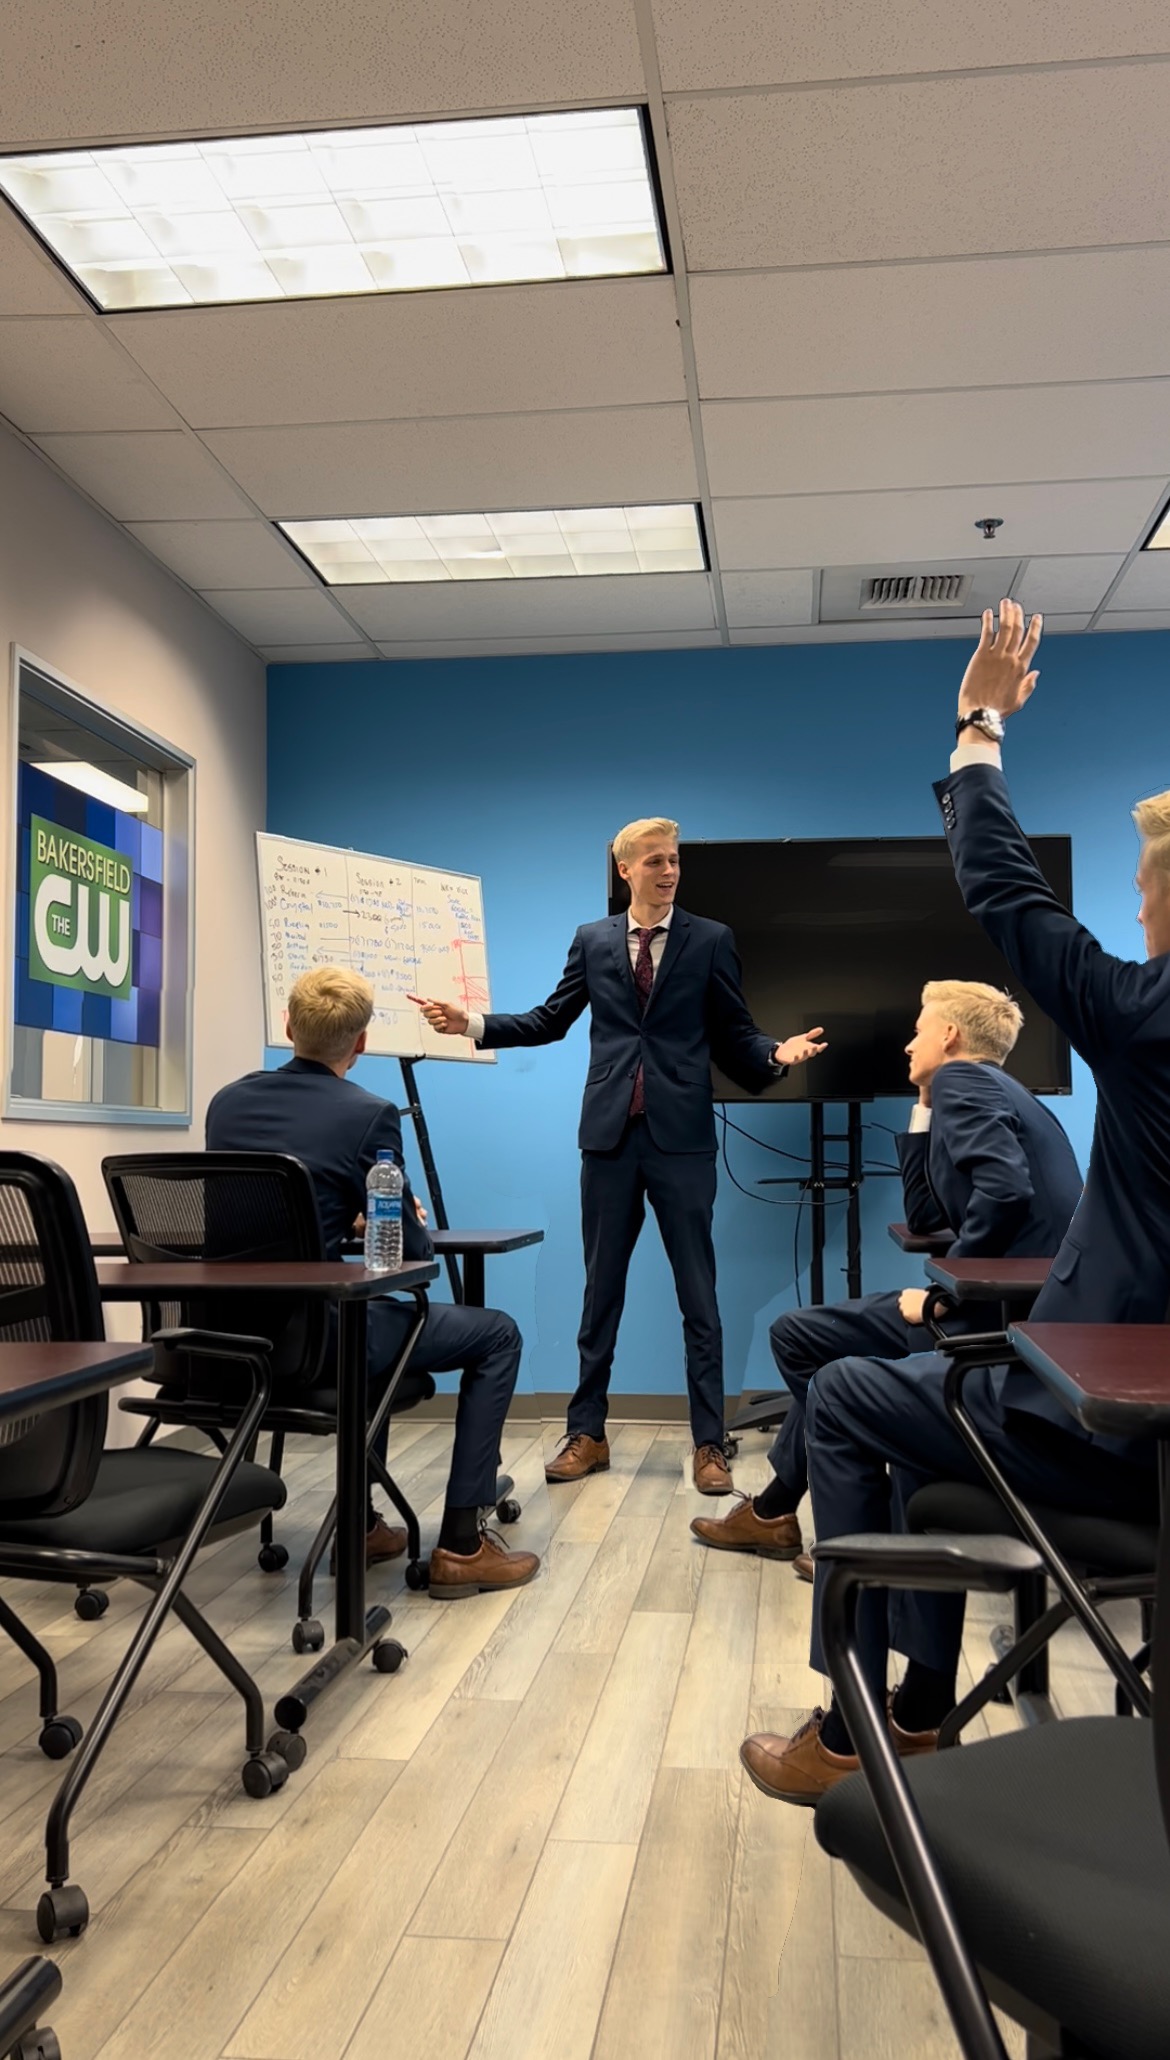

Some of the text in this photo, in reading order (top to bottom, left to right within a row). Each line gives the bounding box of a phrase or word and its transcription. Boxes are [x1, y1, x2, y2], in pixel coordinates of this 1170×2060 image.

[37, 829, 130, 894] BAKERSFIELD
[395, 878, 402, 886] 2
[34, 873, 130, 987] THE CW
